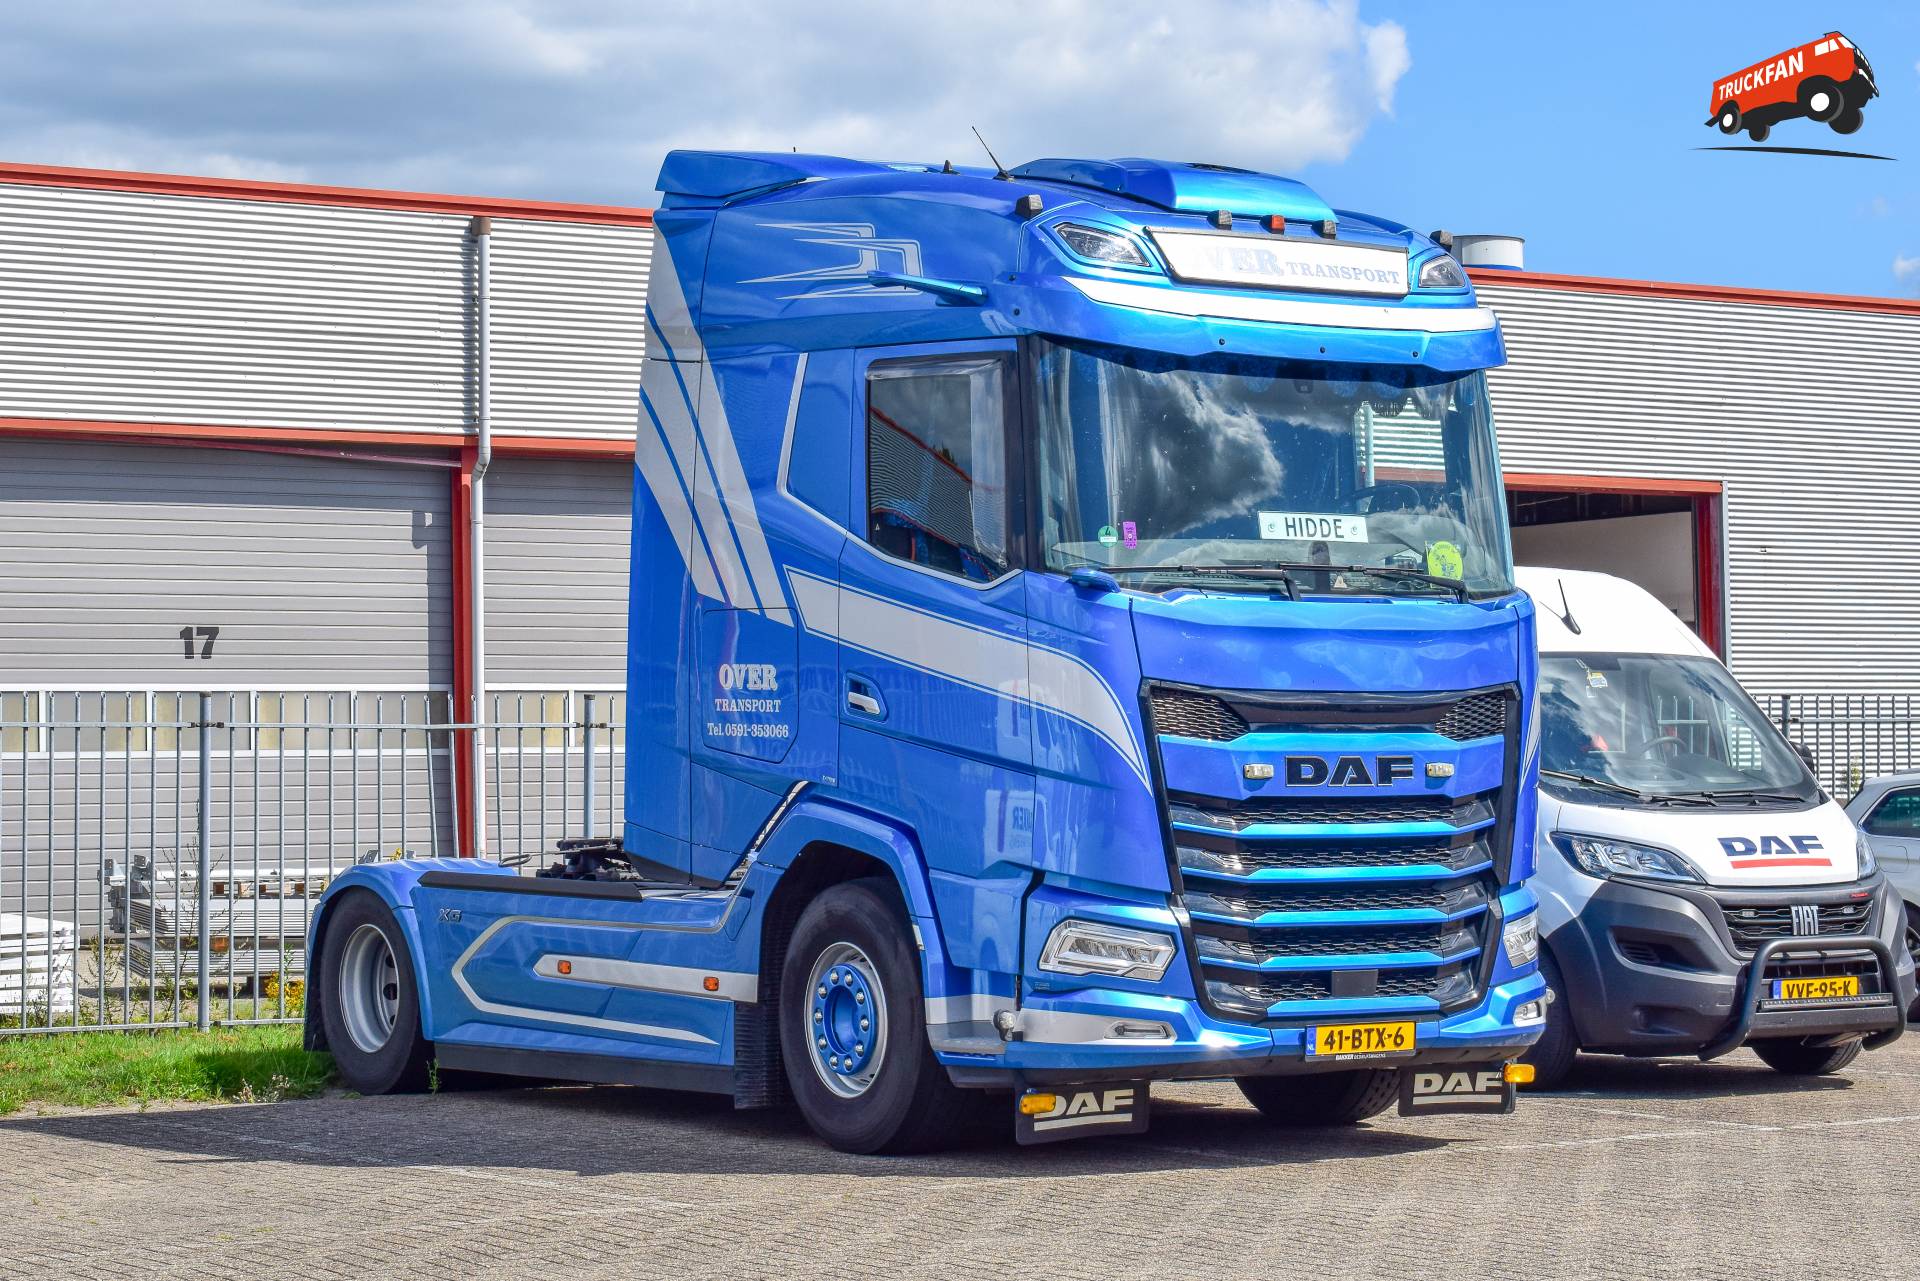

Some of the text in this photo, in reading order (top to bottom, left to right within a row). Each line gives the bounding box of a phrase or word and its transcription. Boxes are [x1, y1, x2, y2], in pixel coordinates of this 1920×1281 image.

[1285, 261, 1400, 285] TRANSPORT
[1284, 517, 1345, 539] HIDDE
[179, 626, 220, 660] 17
[718, 663, 779, 692] OVER
[714, 698, 782, 713] TRANSPORT
[1285, 756, 1414, 787] DAF
[1717, 835, 1825, 857] DAF
[1790, 905, 1819, 936] FIAT
[1786, 981, 1851, 998] VVF-95-K
[1324, 1026, 1405, 1051] 41-BTX-6
[1414, 1071, 1503, 1094] DAF
